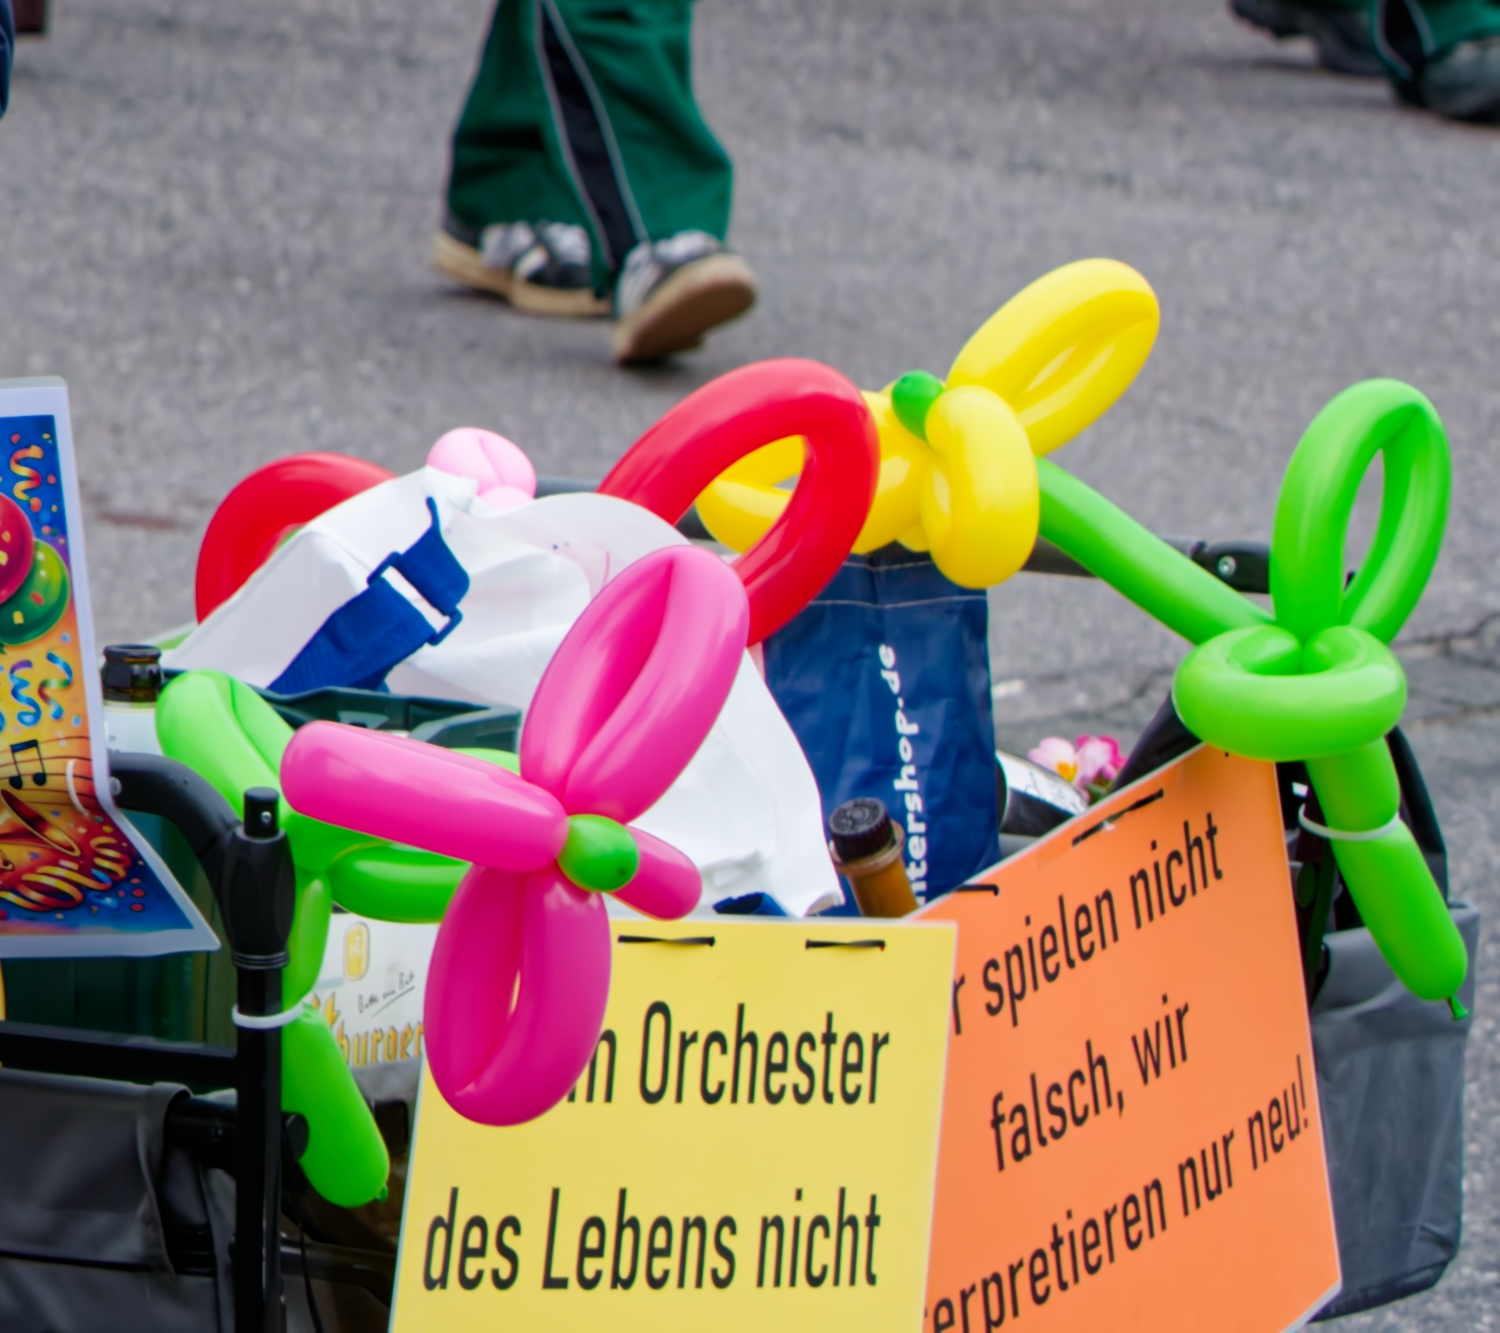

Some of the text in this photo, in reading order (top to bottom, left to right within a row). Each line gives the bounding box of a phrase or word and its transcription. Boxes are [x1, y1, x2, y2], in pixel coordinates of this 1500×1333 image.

[878, 643, 929, 905] ntershop.de
[982, 895, 1120, 1027] spielen
[1129, 811, 1223, 930] nicht
[639, 1000, 890, 1105] Orchester
[990, 993, 1190, 1173] falsch, wir
[423, 1187, 882, 1291] des Lebens nicht
[924, 1054, 1310, 1333] erpretieren nur neu!
